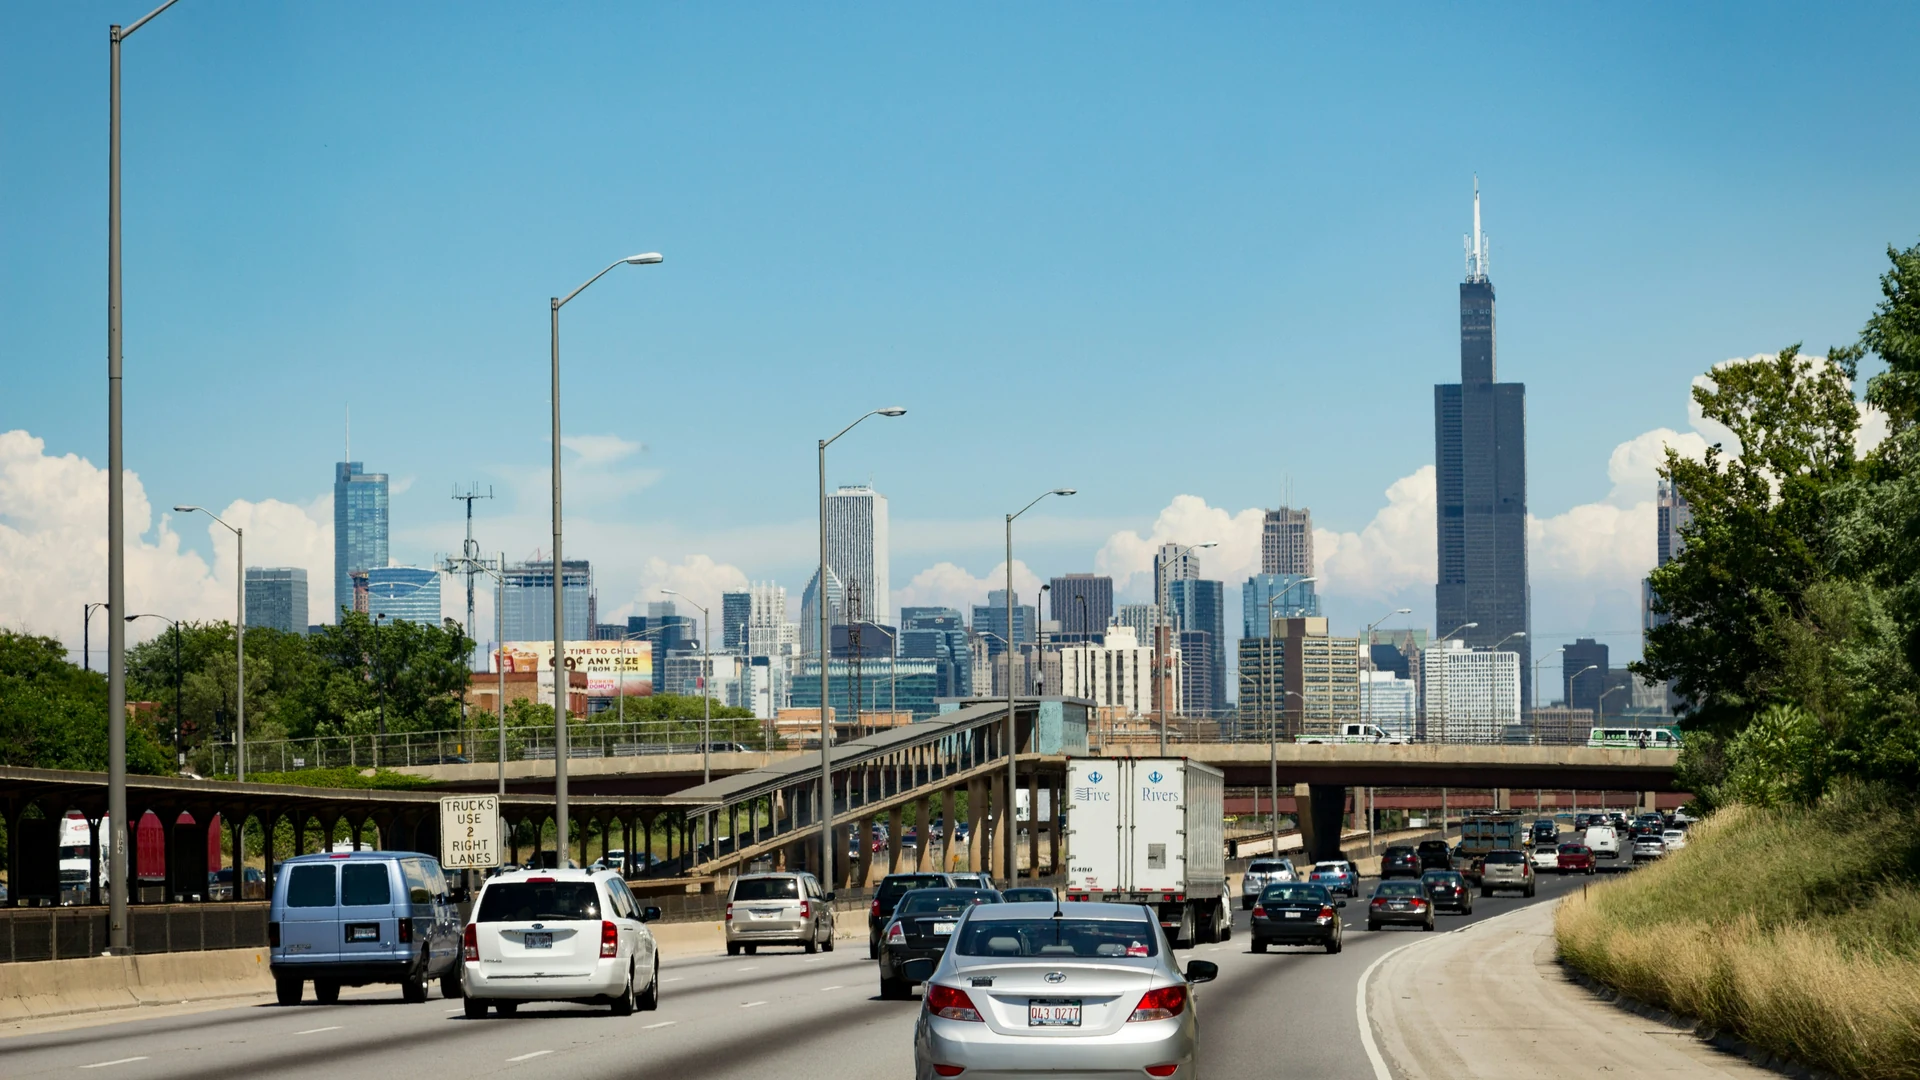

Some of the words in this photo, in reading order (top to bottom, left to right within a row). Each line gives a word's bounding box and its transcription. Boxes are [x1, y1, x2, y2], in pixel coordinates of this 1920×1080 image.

[588, 657, 610, 665] ANY
[614, 657, 639, 665] SZE
[1086, 787, 1110, 801] Five
[1142, 787, 1179, 801] Rivers
[445, 799, 494, 812] TRUCKS
[457, 813, 482, 824] USE
[466, 826, 474, 837] 2
[452, 839, 488, 852] RIGHT
[450, 853, 491, 865] LANES
[1055, 1007, 1079, 1020] 0277
